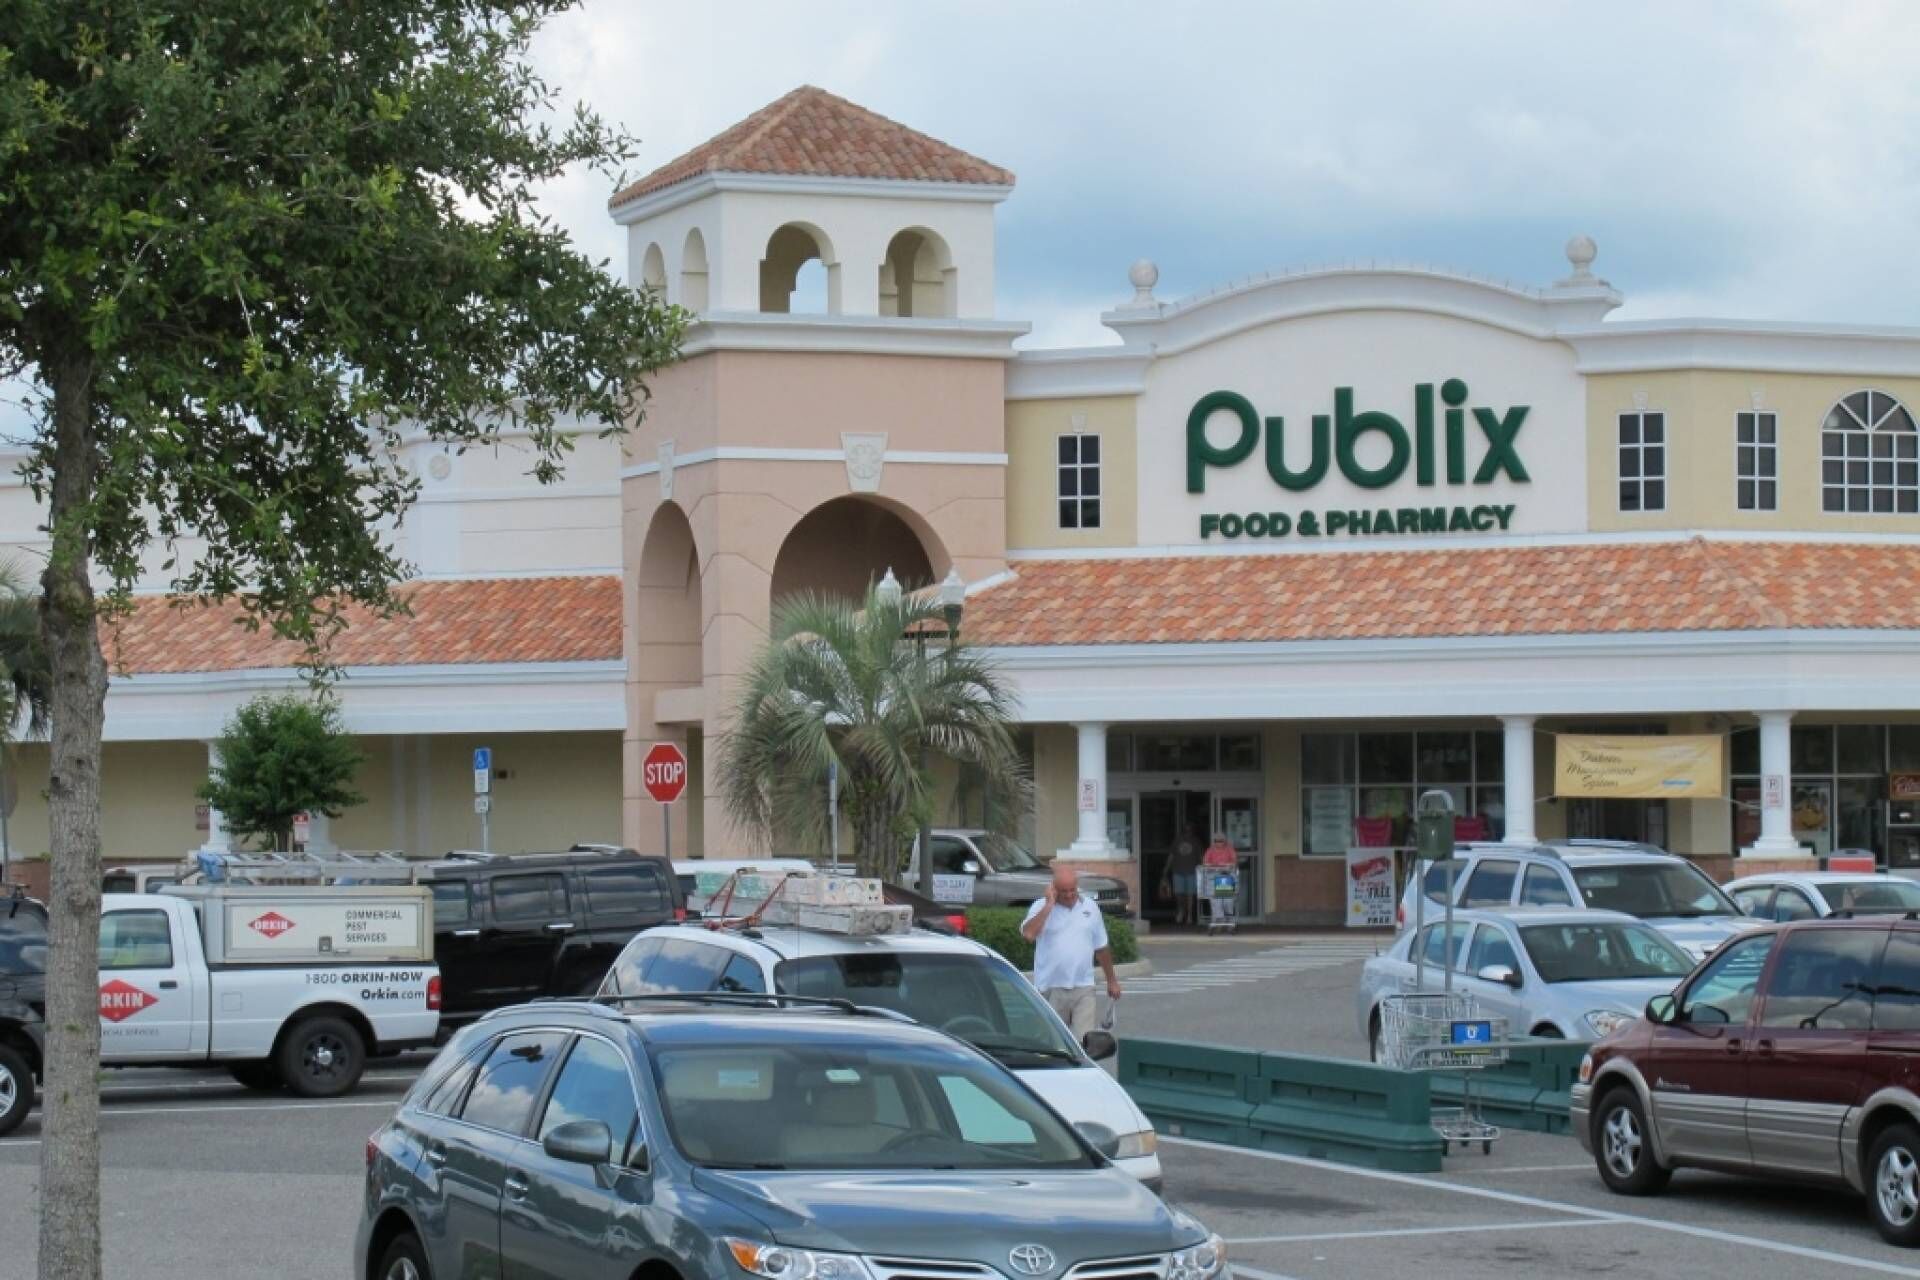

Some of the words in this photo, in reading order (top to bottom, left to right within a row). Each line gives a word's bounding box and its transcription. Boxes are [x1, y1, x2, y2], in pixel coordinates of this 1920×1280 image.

[1186, 378, 1532, 494] Publix
[1200, 512, 1292, 539] FOOD
[1297, 509, 1322, 537] &
[1325, 503, 1517, 536] PHARMACY
[646, 762, 684, 785] STOP
[345, 910, 402, 920] COMMERCIAL
[253, 919, 289, 930] ORKIN
[345, 921, 368, 931] PEST
[345, 933, 388, 943] SERVICES
[341, 972, 424, 982] ORKIN-NOW
[101, 991, 144, 1009] RKIN
